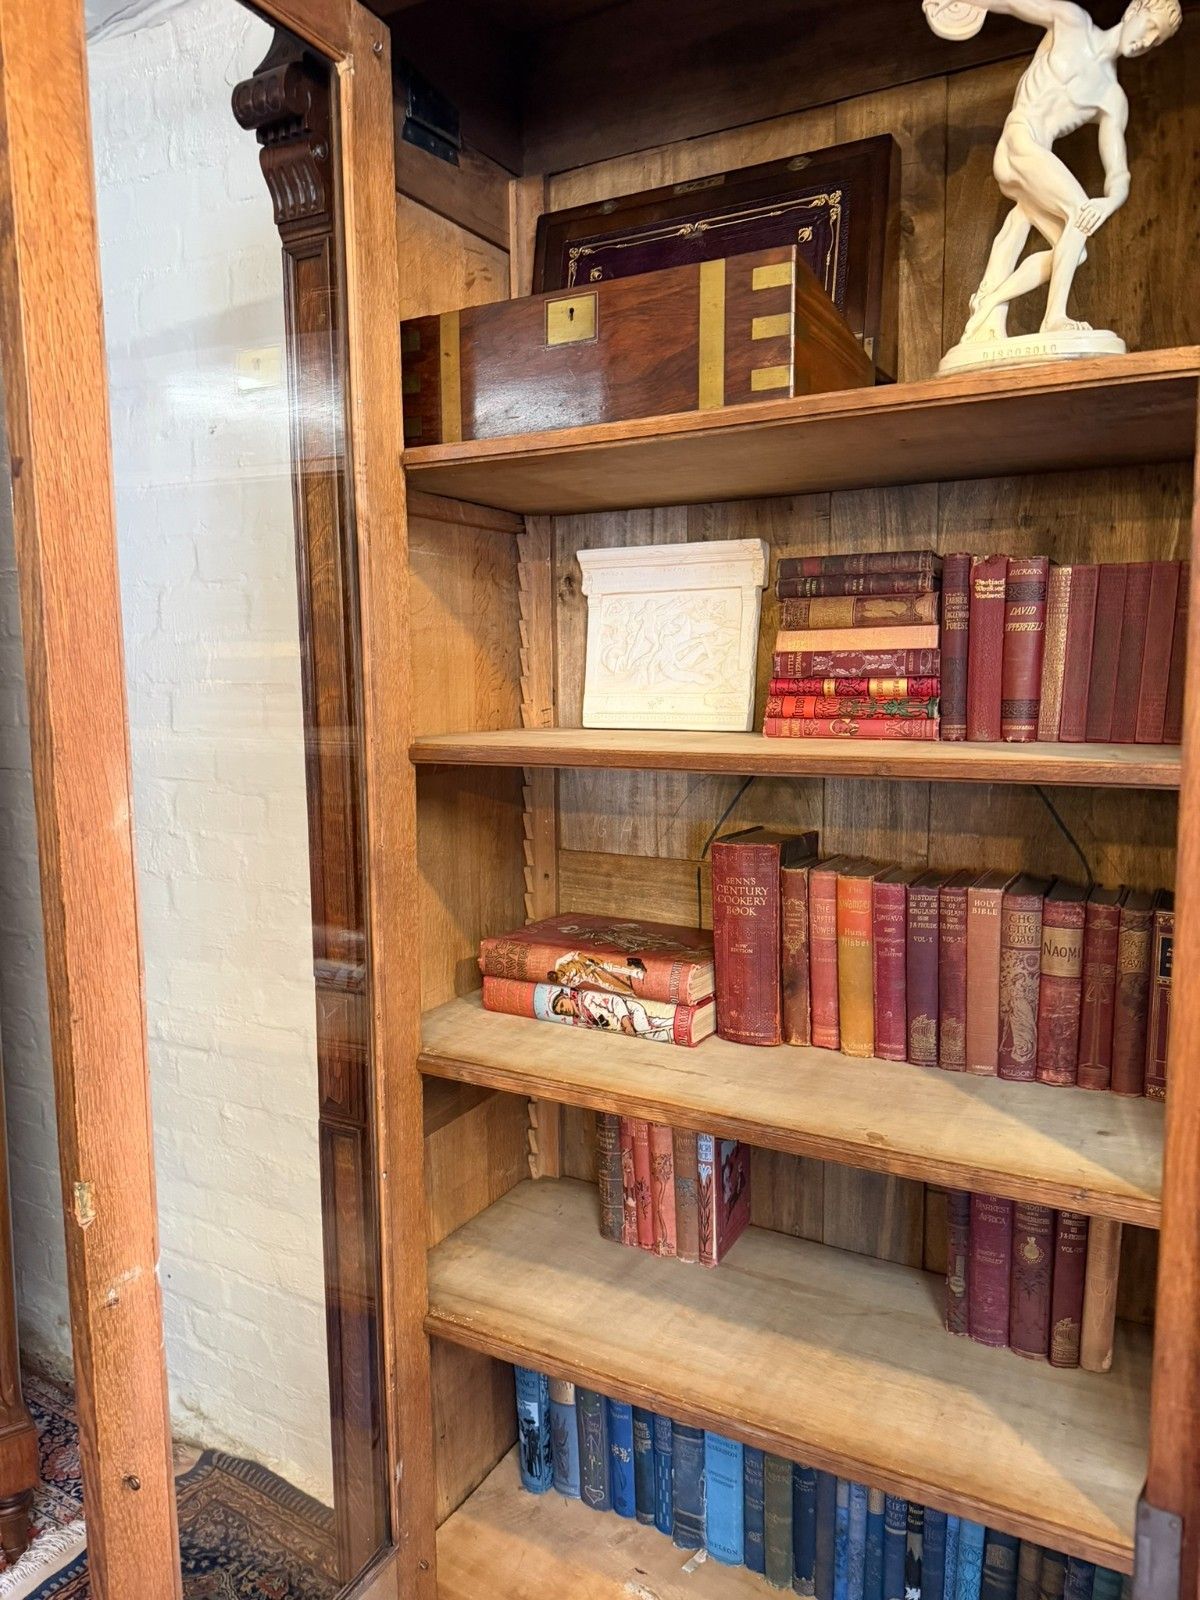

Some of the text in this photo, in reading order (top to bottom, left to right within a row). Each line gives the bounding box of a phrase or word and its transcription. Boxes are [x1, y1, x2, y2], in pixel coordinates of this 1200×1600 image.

[1009, 606, 1037, 616] DAVID
[788, 653, 796, 676] LITTLE
[791, 695, 805, 718] TUBBY
[716, 884, 769, 897] CENTURY
[717, 896, 768, 907] COOKERY
[909, 894, 938, 902] HISTORY
[974, 899, 995, 908] HOLY
[726, 906, 757, 917] BOOK
[815, 904, 830, 913] THE
[971, 907, 998, 916] BIBLE
[1008, 914, 1035, 924] THE
[812, 923, 836, 935] POWER
[844, 928, 868, 937] Hume
[1008, 933, 1034, 945] WAY
[1043, 939, 1082, 962] NAOMI
[1000, 1067, 1034, 1077] NELSON
[976, 1200, 1010, 1214] DARKEST
[979, 1213, 1006, 1225] AFRICA
